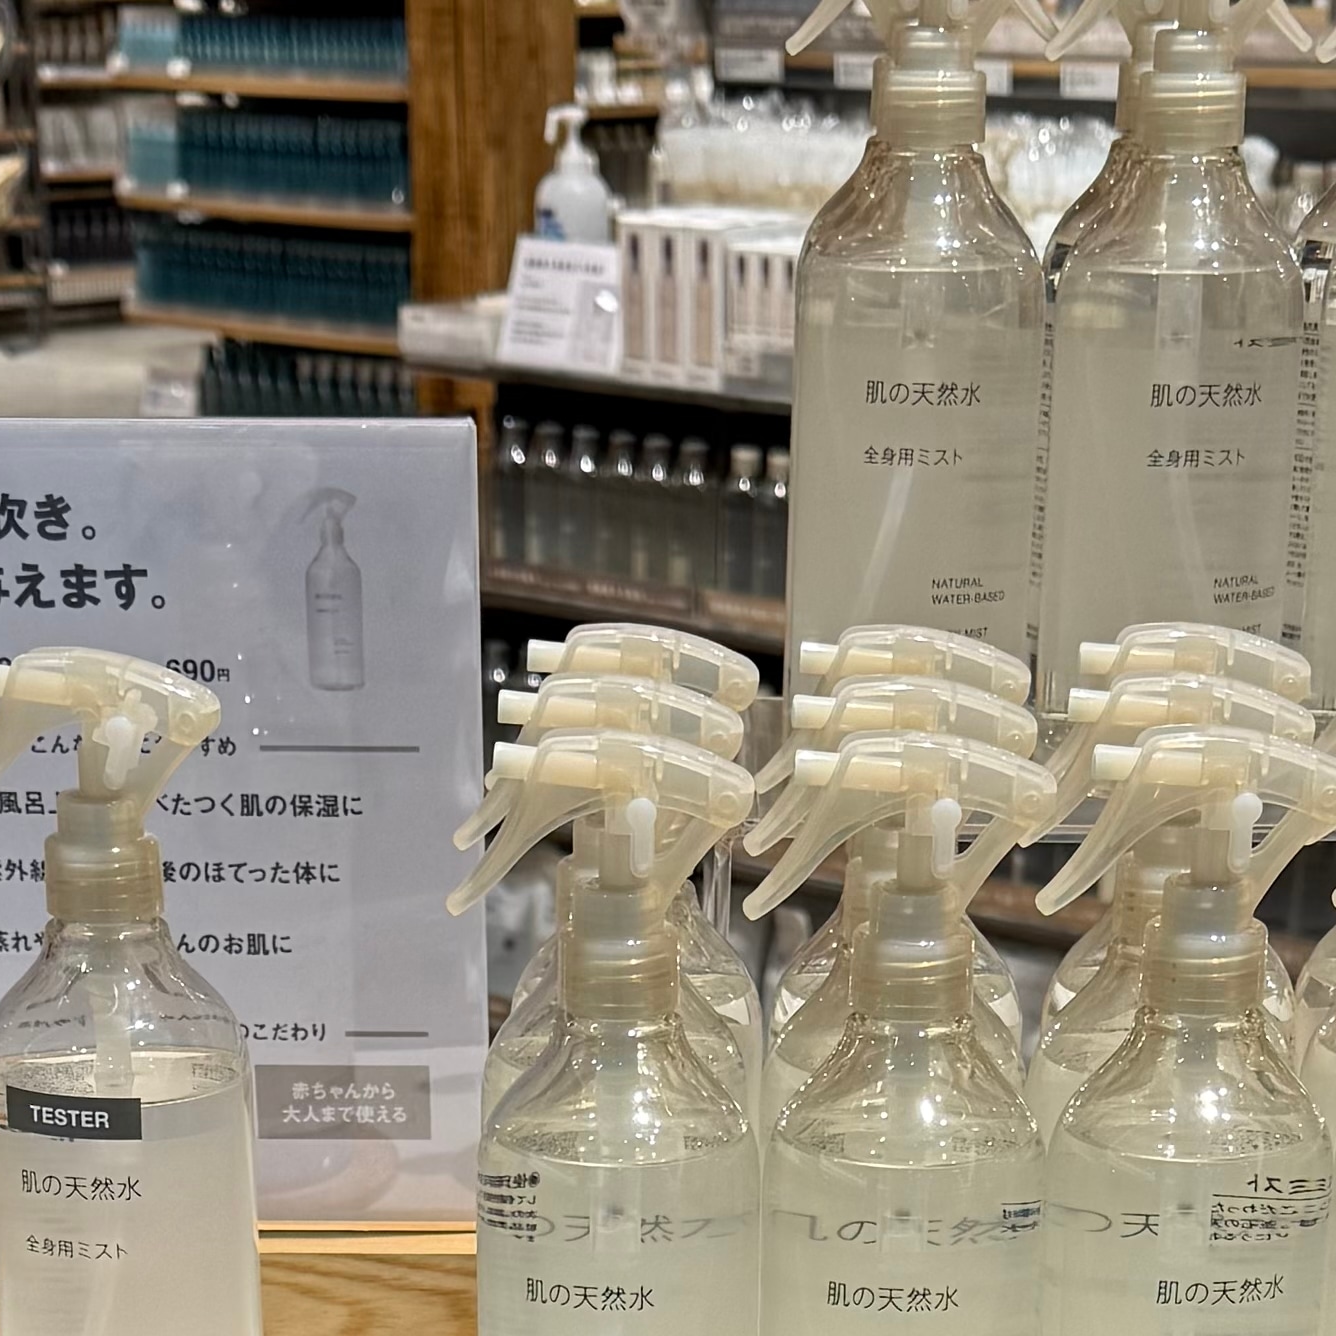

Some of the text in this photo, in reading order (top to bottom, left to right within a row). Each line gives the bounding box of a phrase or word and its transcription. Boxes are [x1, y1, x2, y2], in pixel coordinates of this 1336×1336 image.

[866, 380, 981, 407] 肌の天然水
[1150, 381, 1263, 408] 肌の天然水
[864, 445, 963, 467] 全身用ミスト
[1147, 449, 1245, 468] 全身用ミスト
[931, 577, 984, 590] NATURAL
[1213, 575, 1259, 588] NATURAL
[30, 1104, 110, 1131] TESTER
[282, 1104, 408, 1125] 大人まで使える
[21, 1169, 142, 1201] 肌の天然水
[25, 1234, 128, 1260] 全身用ミスト
[525, 1277, 655, 1311] 肌の天然水
[827, 1281, 959, 1313] 肌の天然水
[1156, 1274, 1284, 1305] 肌の天然水
